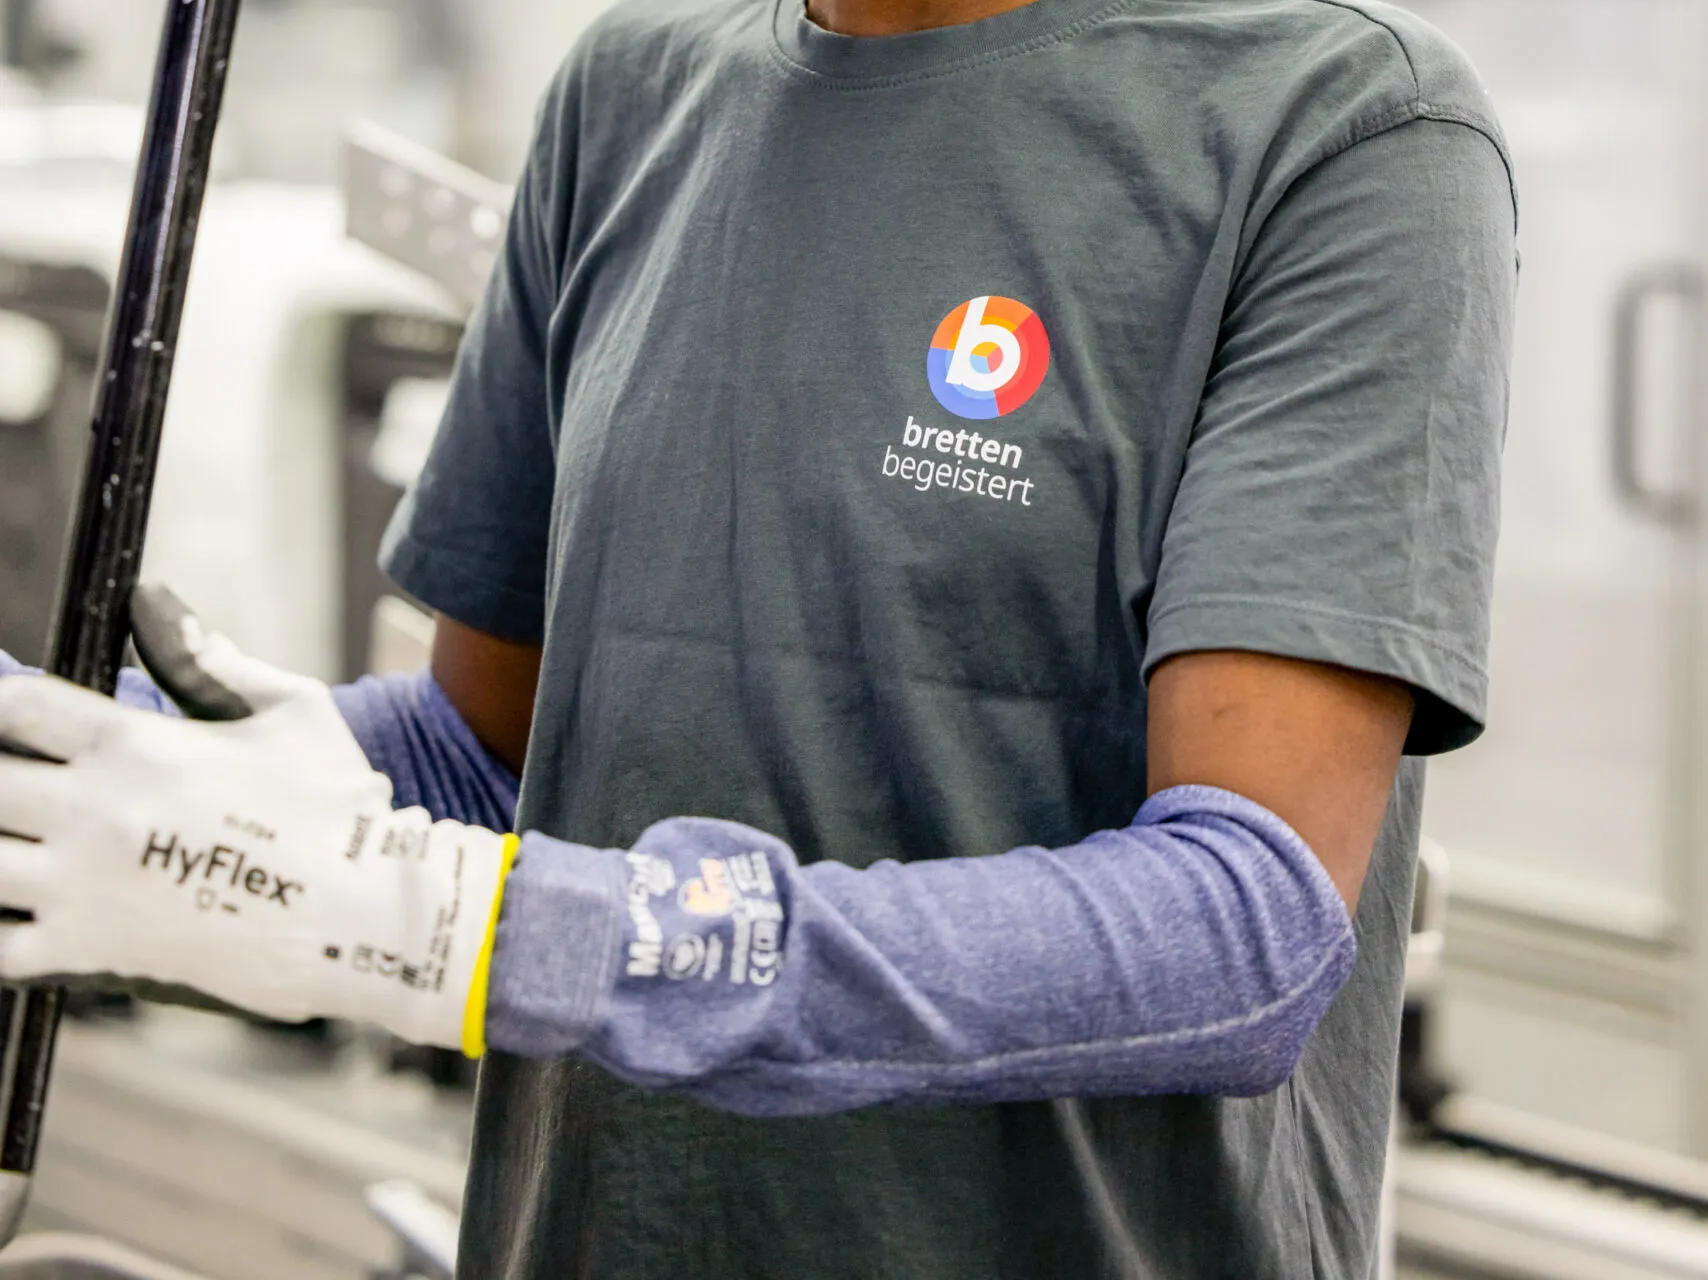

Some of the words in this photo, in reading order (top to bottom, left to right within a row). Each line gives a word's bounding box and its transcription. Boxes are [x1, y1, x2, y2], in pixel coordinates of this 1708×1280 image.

[902, 415, 1023, 469] bretten
[881, 445, 1035, 506] begeistert
[141, 831, 292, 908] HyFlex
